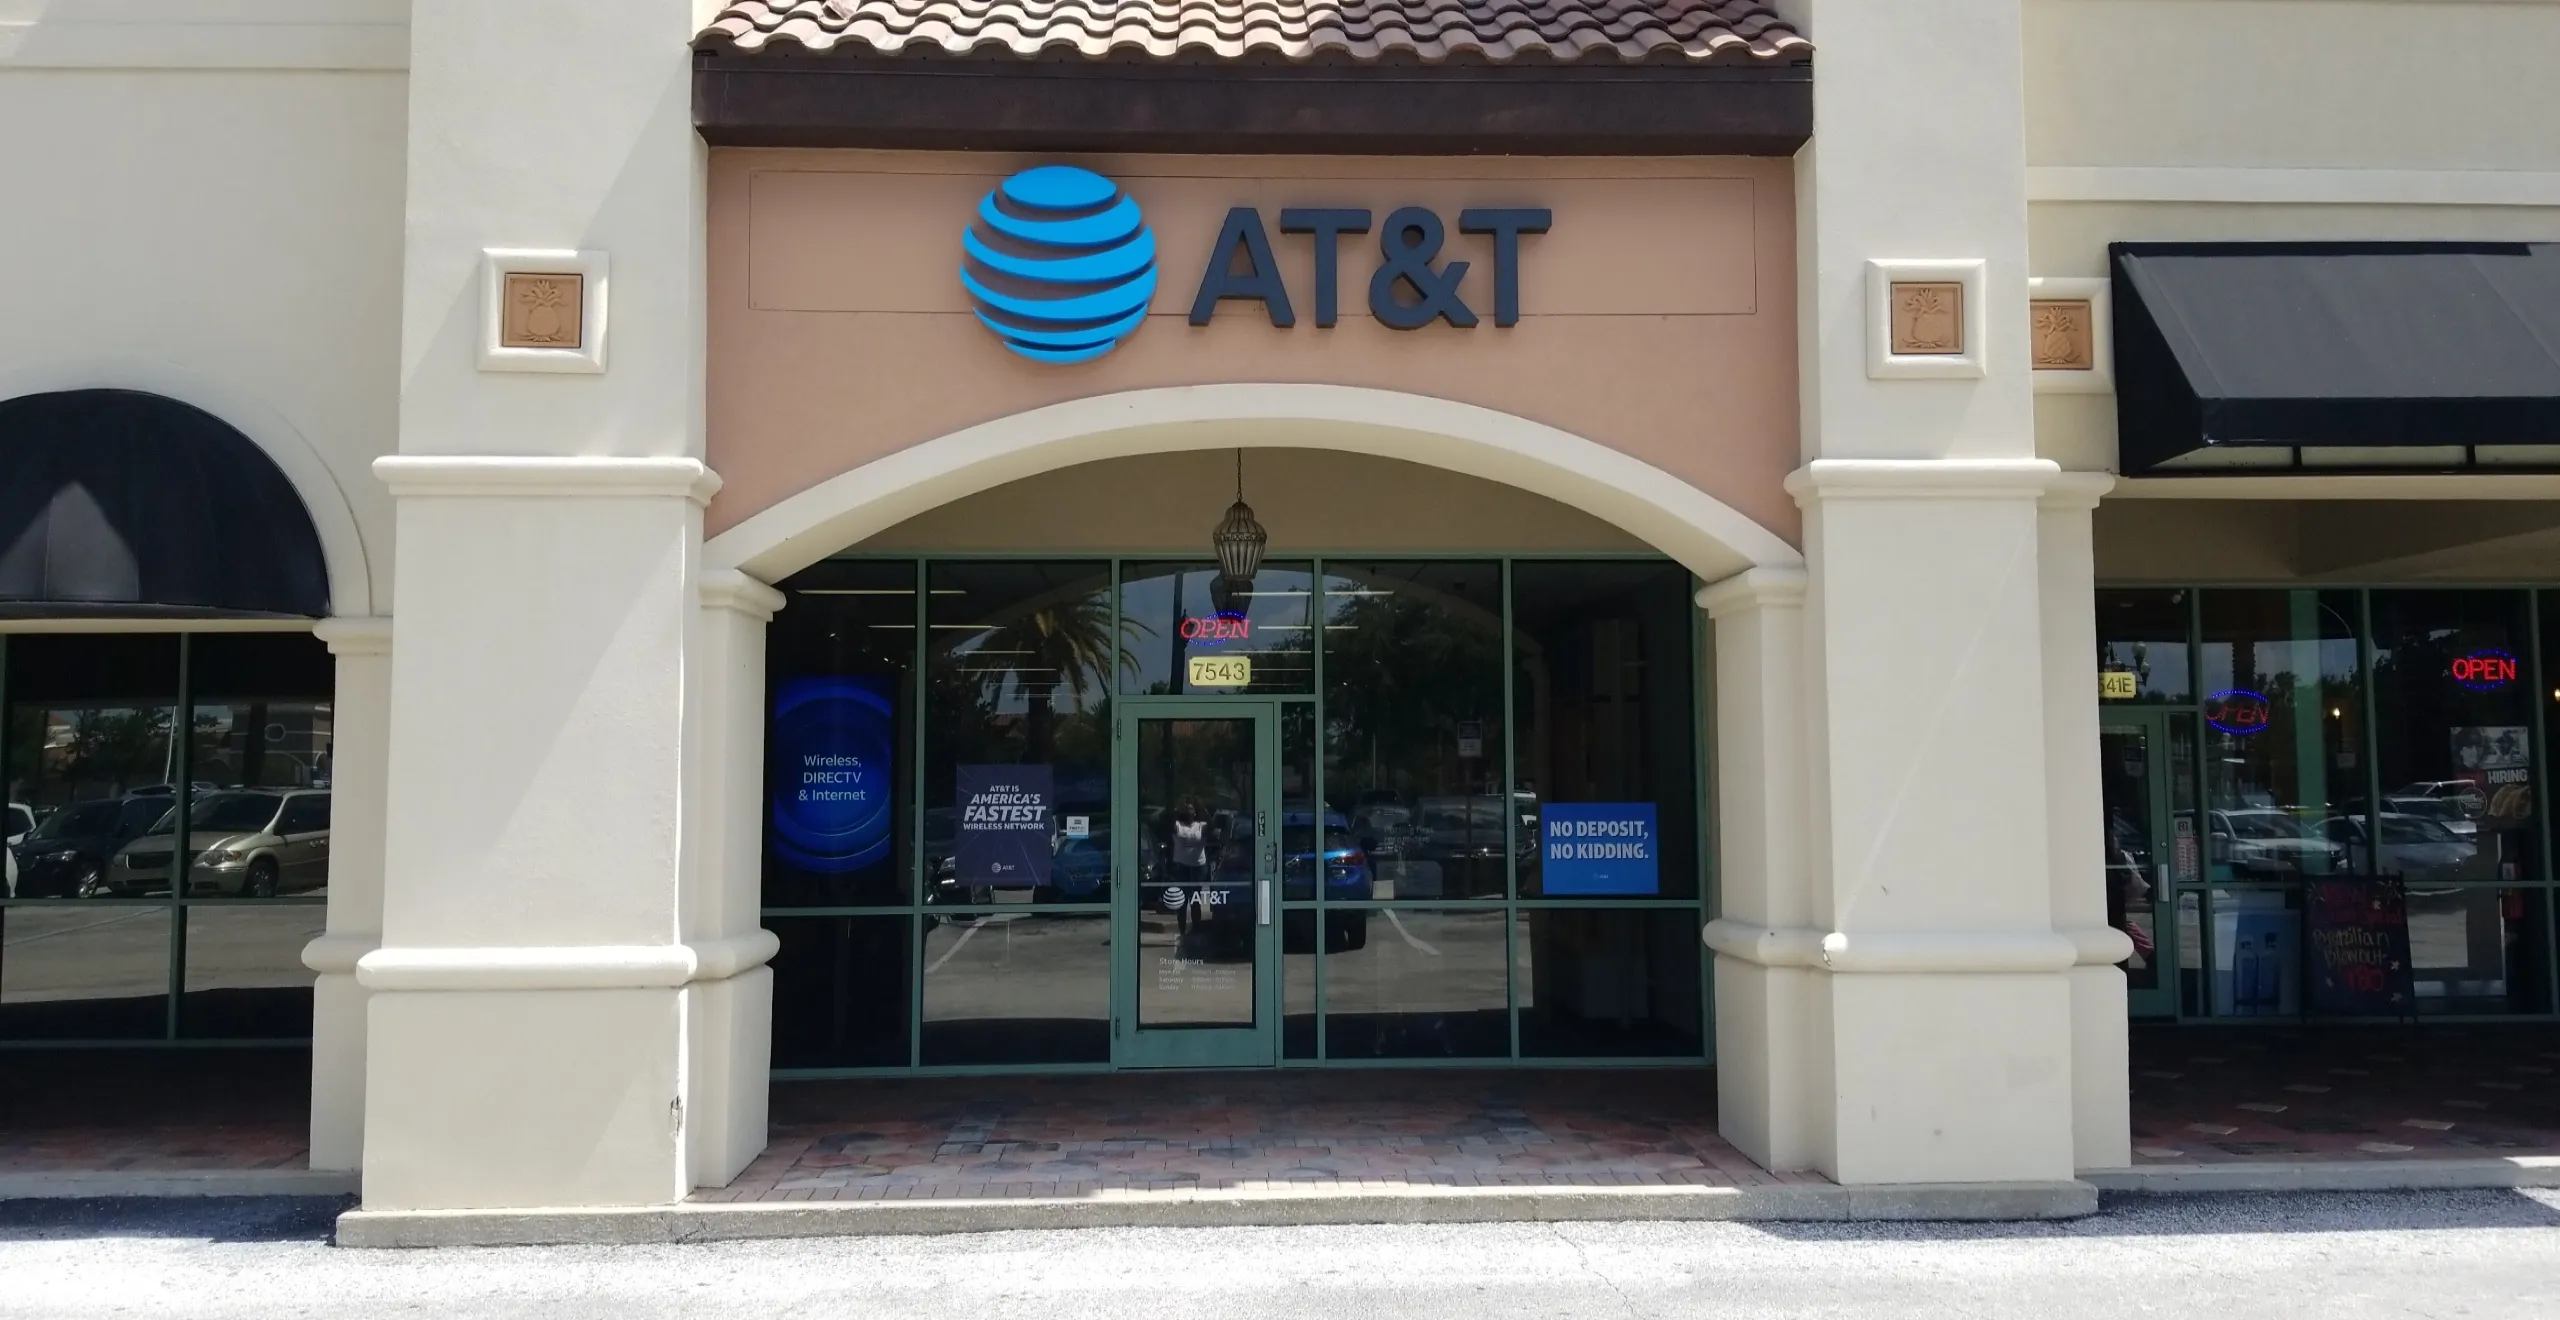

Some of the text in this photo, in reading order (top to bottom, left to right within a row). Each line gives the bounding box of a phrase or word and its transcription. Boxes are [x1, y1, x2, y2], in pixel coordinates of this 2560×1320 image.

[1188, 206, 1552, 331] AT&T
[1180, 617, 1251, 639] OPEN
[1193, 662, 1245, 681] 7543
[2452, 658, 2516, 680] OPEN
[803, 753, 862, 767] Wireless,
[803, 771, 862, 784] DIRECTV
[2487, 768, 2528, 784] HIRING
[798, 789, 866, 801] & Internet
[970, 793, 1041, 805] AMERICA'S
[963, 805, 1047, 822] FASTEST
[1550, 820, 1649, 840] NO DEPOSIT,
[1550, 843, 1650, 859] NO KIDDING.
[1190, 890, 1230, 905] AT&T
